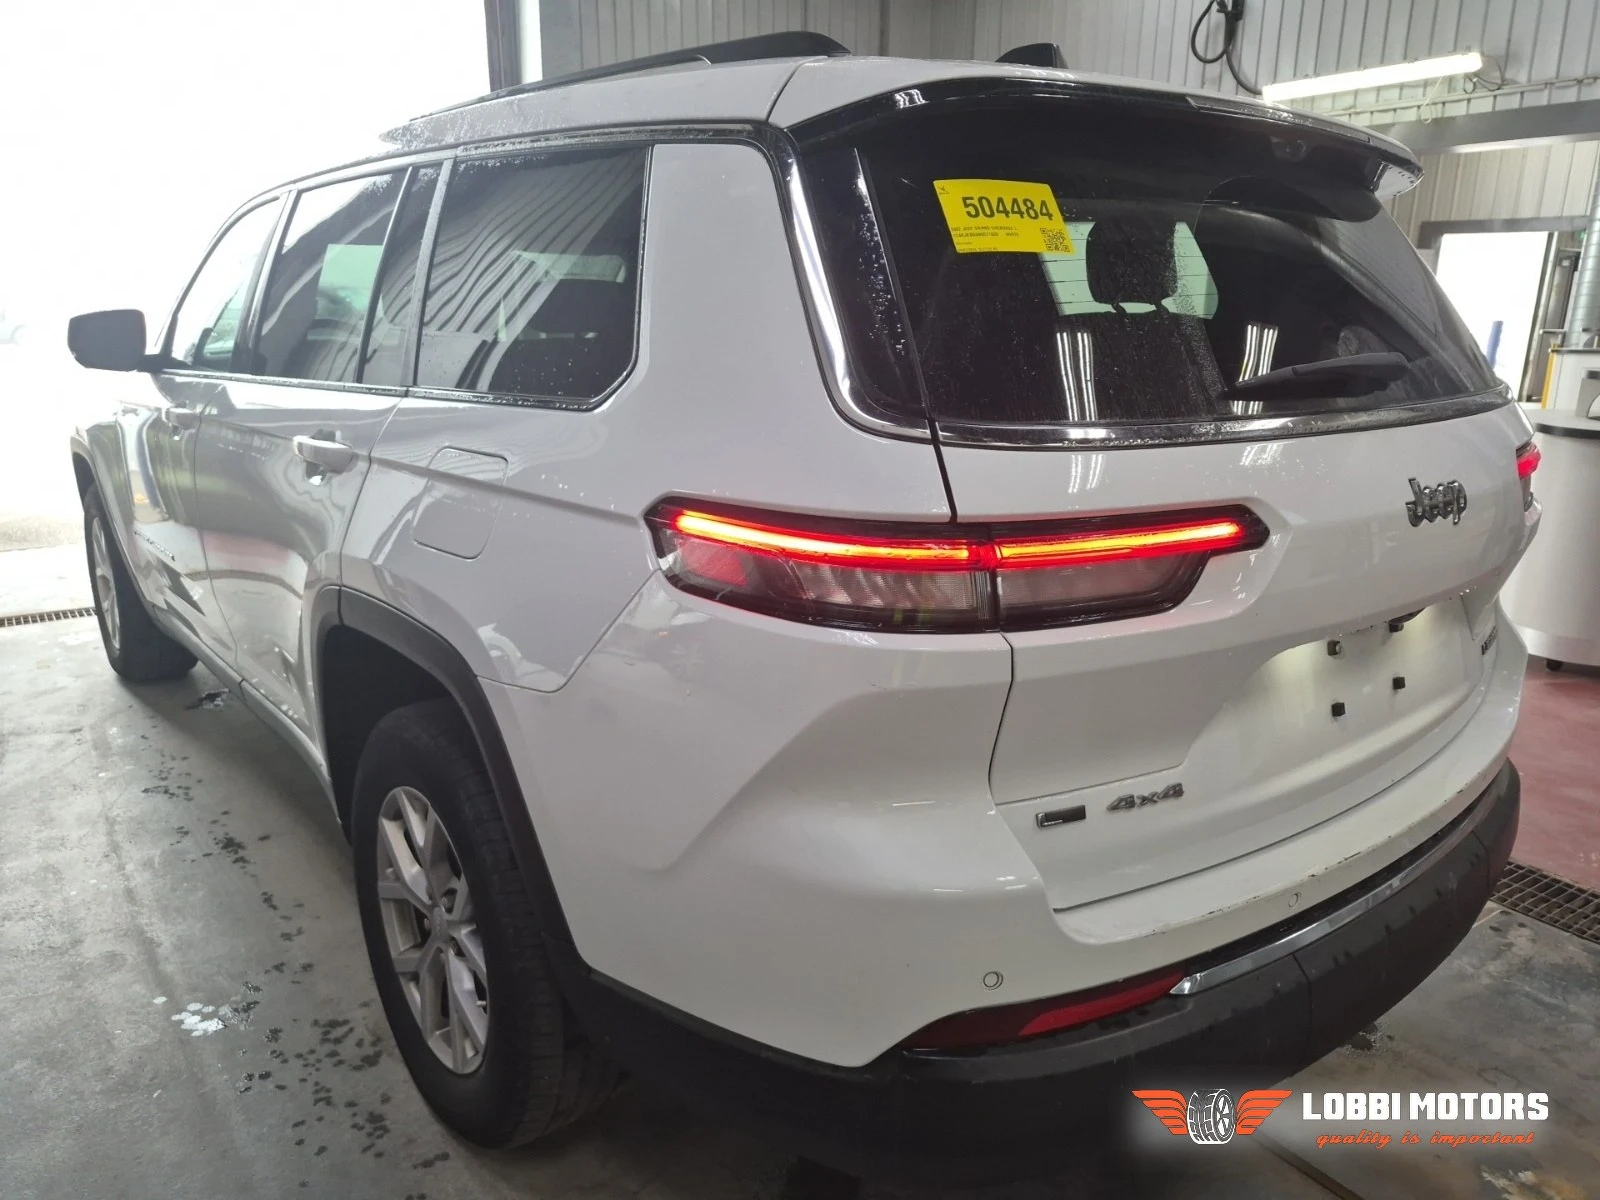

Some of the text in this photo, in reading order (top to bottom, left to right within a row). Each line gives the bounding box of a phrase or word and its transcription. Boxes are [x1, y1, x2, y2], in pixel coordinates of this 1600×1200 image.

[961, 196, 1053, 220] 504484
[1405, 478, 1467, 527] Jeep
[1107, 783, 1184, 811] 4x4
